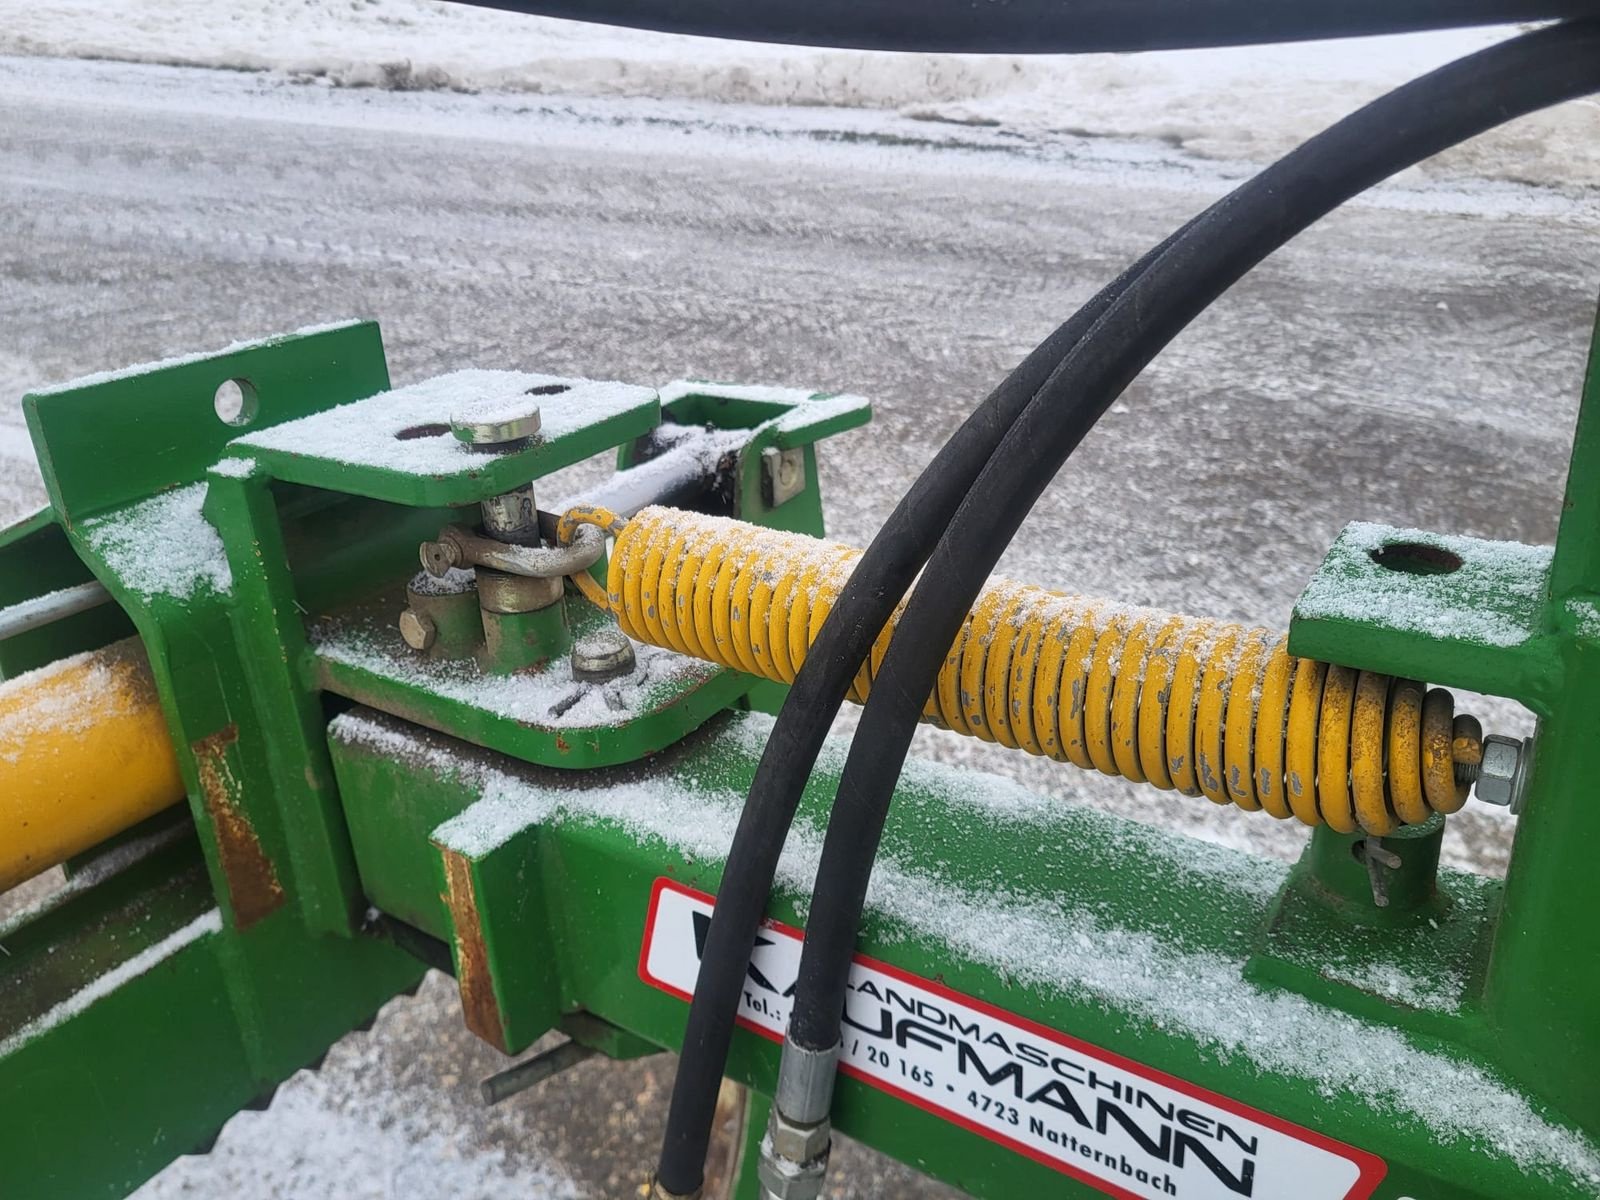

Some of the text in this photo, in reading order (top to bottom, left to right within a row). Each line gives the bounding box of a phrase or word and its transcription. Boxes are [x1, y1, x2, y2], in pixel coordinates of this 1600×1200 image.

[743, 990, 781, 1021] Tel.:
[868, 1045, 890, 1068] 20
[899, 1058, 935, 1088] 165
[967, 1090, 1019, 1126] 4723
[1030, 1115, 1177, 1197] Natternbach
